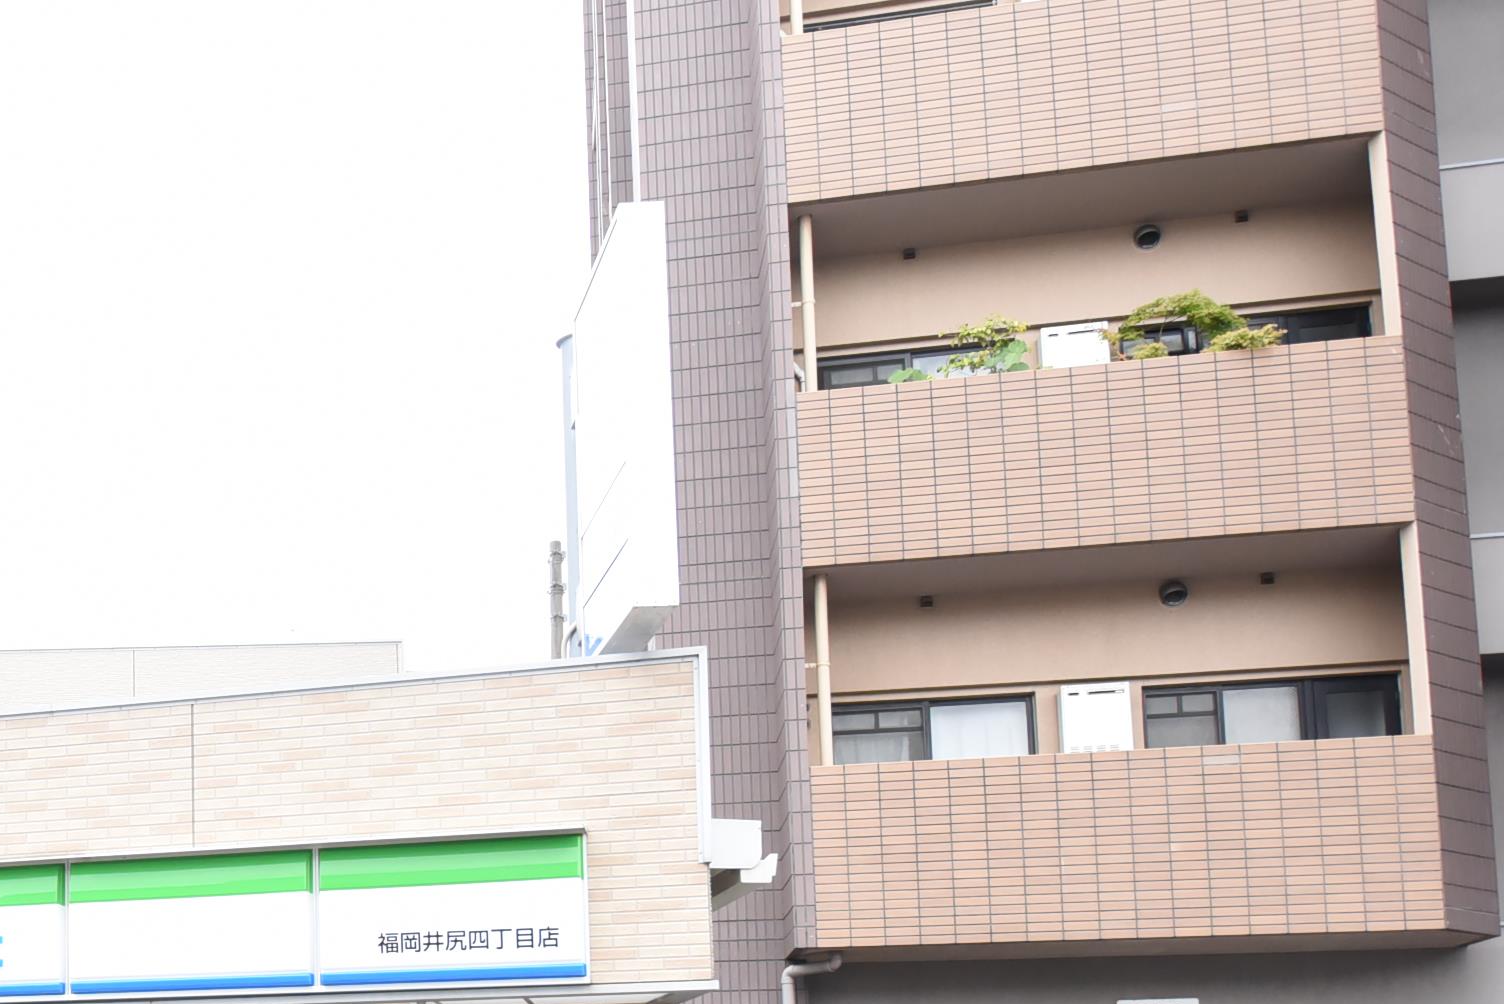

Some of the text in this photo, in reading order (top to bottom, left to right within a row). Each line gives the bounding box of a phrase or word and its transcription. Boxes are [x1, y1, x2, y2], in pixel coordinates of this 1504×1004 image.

[377, 927, 560, 955] 福岡井尻四丁目店
